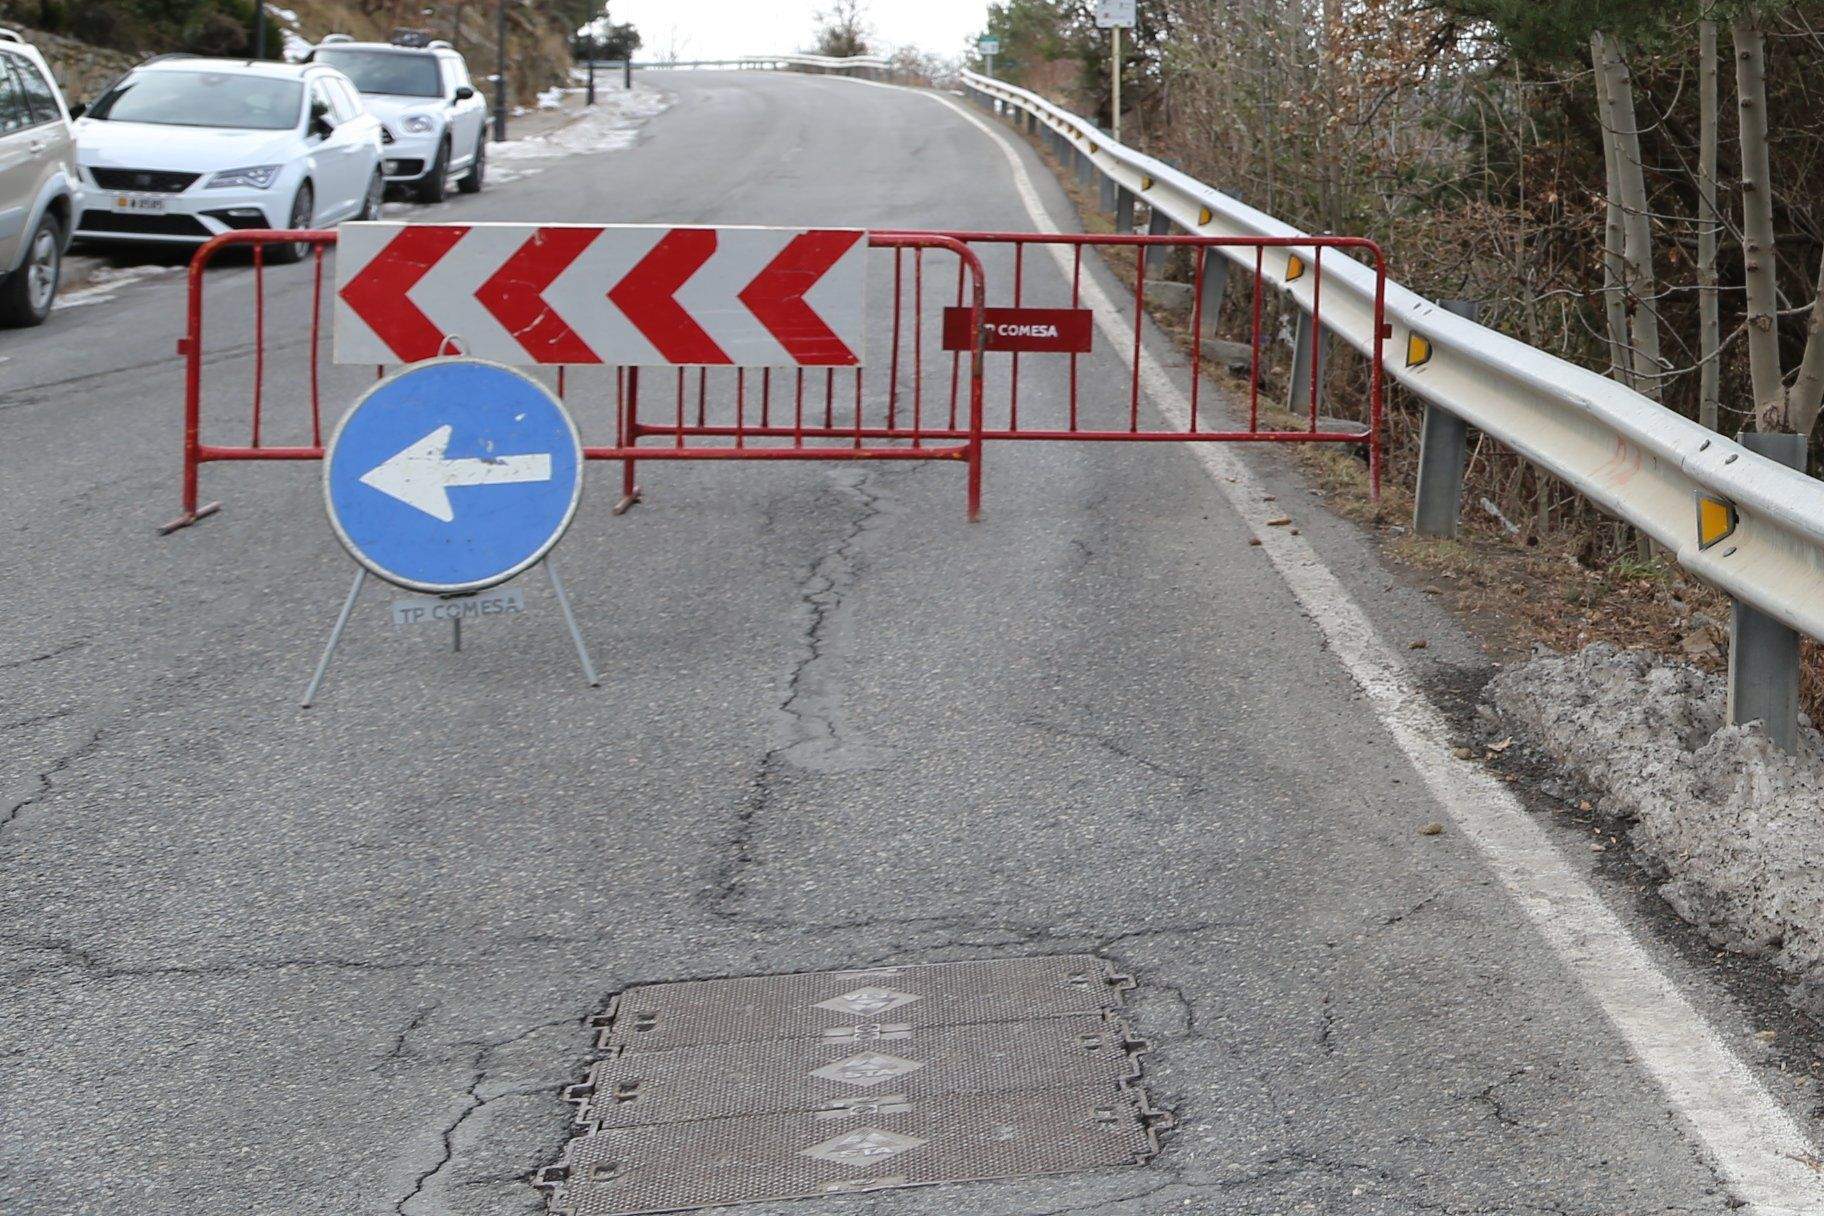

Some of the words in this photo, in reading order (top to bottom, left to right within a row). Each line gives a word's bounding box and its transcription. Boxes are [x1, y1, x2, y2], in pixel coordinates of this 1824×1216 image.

[997, 323, 1058, 338] COMESA
[400, 607, 424, 624] TP
[432, 597, 522, 620] COMESA
